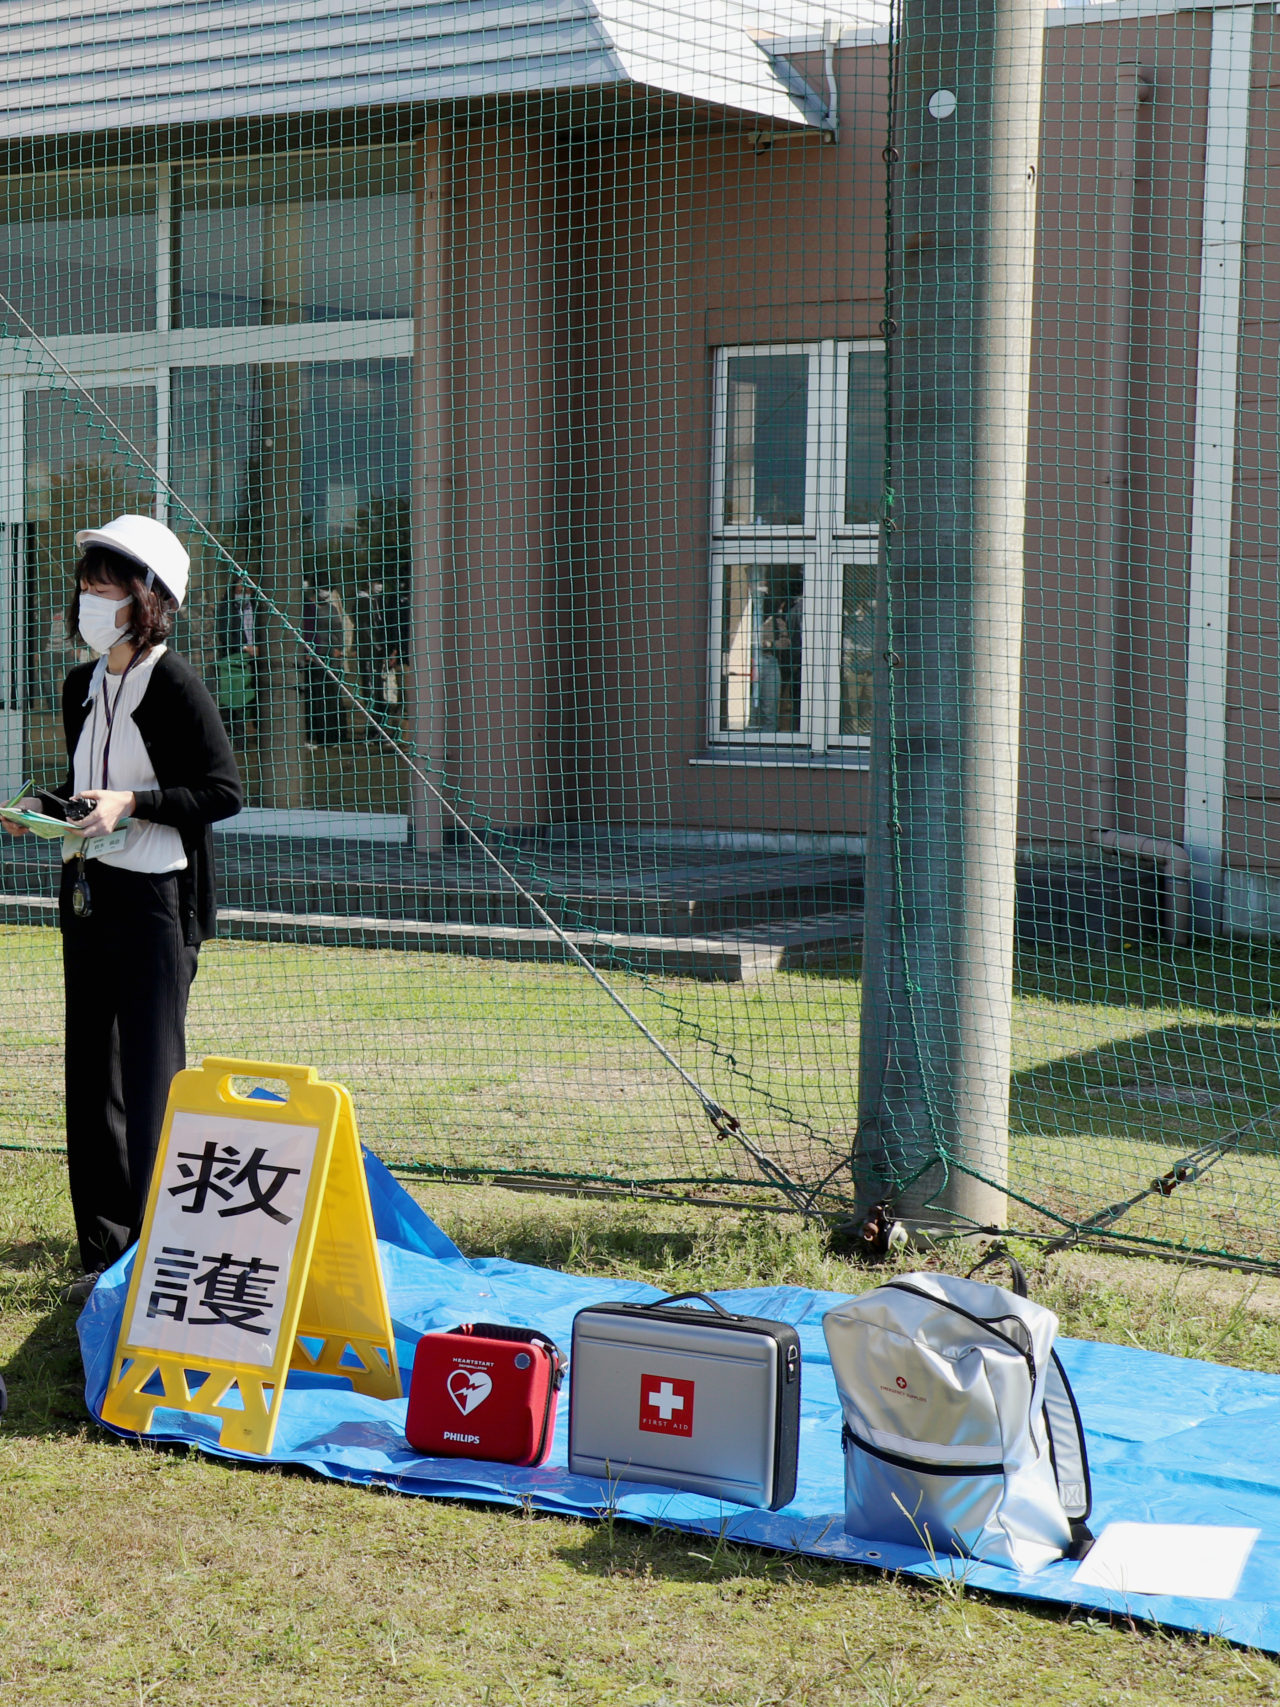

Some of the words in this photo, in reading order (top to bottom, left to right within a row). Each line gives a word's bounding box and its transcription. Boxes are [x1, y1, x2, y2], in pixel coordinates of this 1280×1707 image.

[146, 1141, 301, 1336] 救護
[452, 1357, 494, 1367] HEARTSTART
[643, 1418, 667, 1427] FIRST
[443, 1431, 480, 1444] PHILIPS
